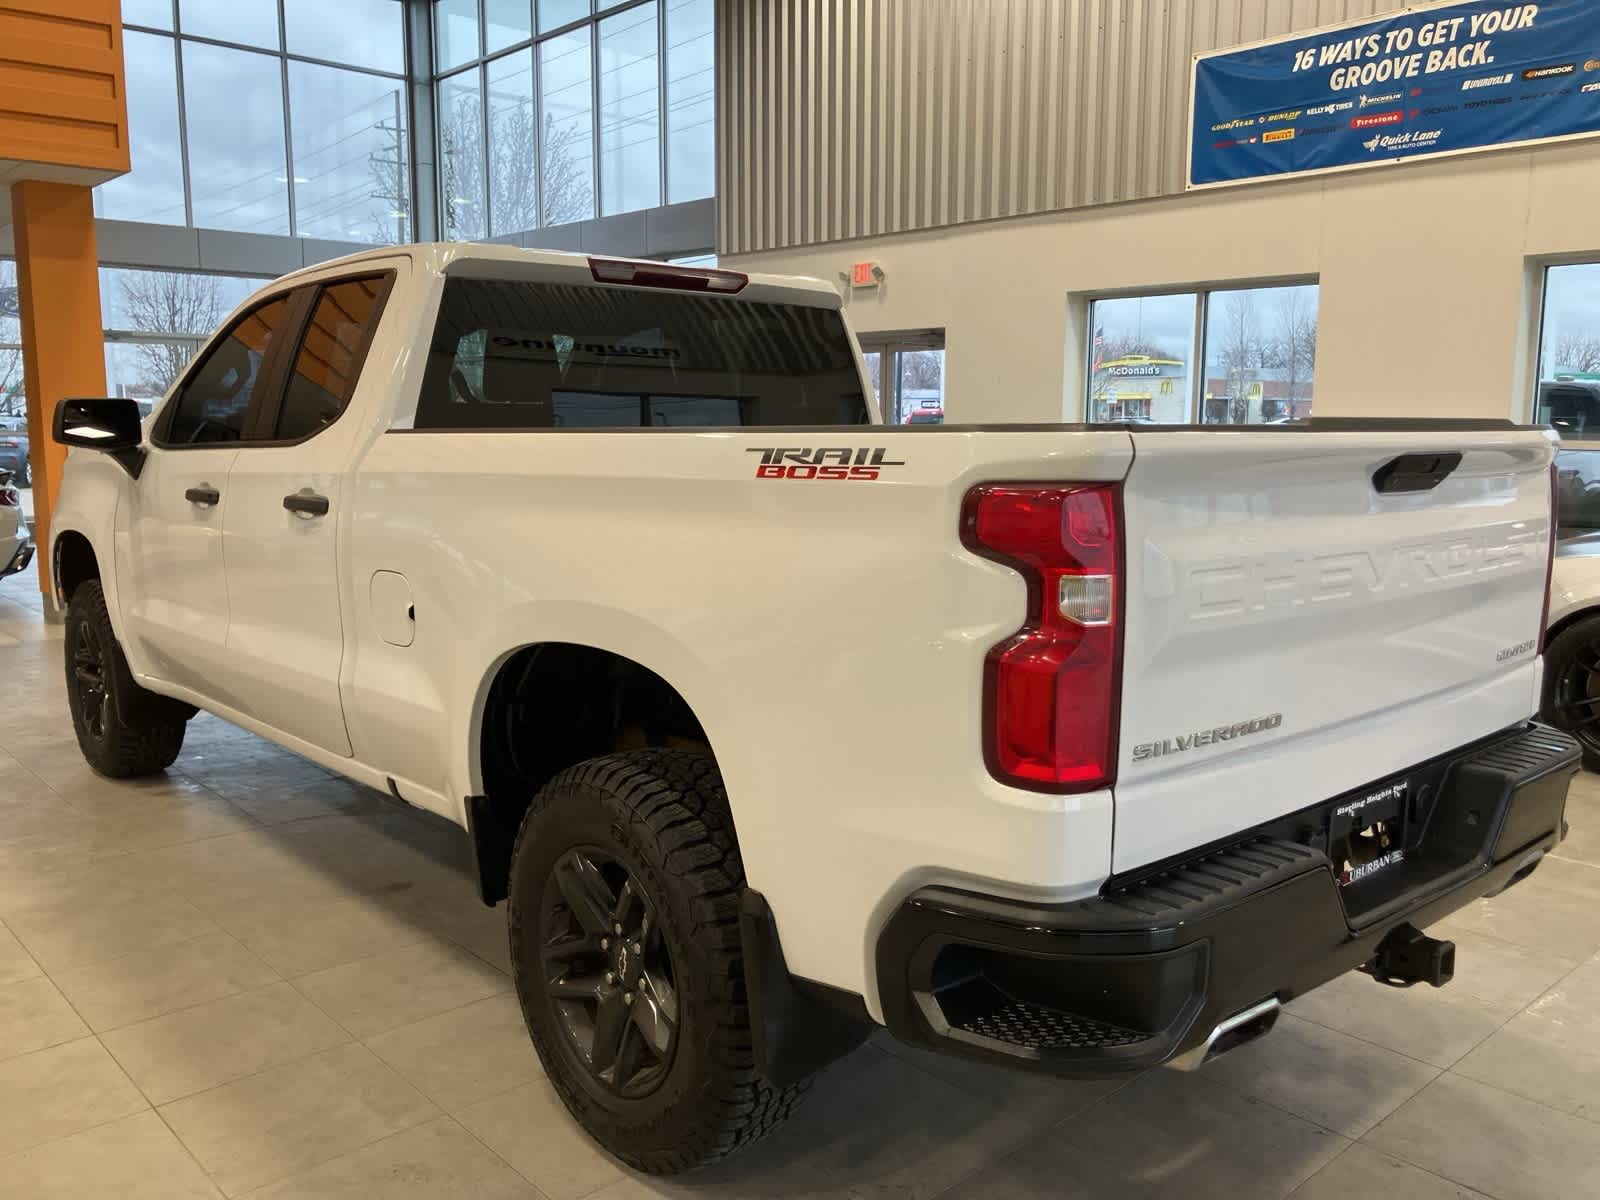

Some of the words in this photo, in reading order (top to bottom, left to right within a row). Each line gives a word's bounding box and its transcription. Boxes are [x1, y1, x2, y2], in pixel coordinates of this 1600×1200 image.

[1292, 48, 1316, 72] 16
[1319, 34, 1381, 67] WAYS
[1385, 27, 1414, 54] TO
[1417, 17, 1464, 47] GET
[1470, 4, 1538, 37] YOUR
[1329, 52, 1423, 91] GROOVE
[1424, 40, 1494, 74] BACK.
[1211, 119, 1254, 131] GOODYEAR
[1356, 114, 1398, 127] Firestone
[1380, 132, 1412, 147] Quick
[1412, 130, 1441, 141] Lane
[1108, 365, 1160, 376] McDonald's
[745, 447, 906, 466] TRAIL
[756, 465, 881, 480] BOSS
[1132, 712, 1282, 763] SILVERADO
[1337, 800, 1365, 816] Sterling
[1366, 788, 1392, 804] Heights
